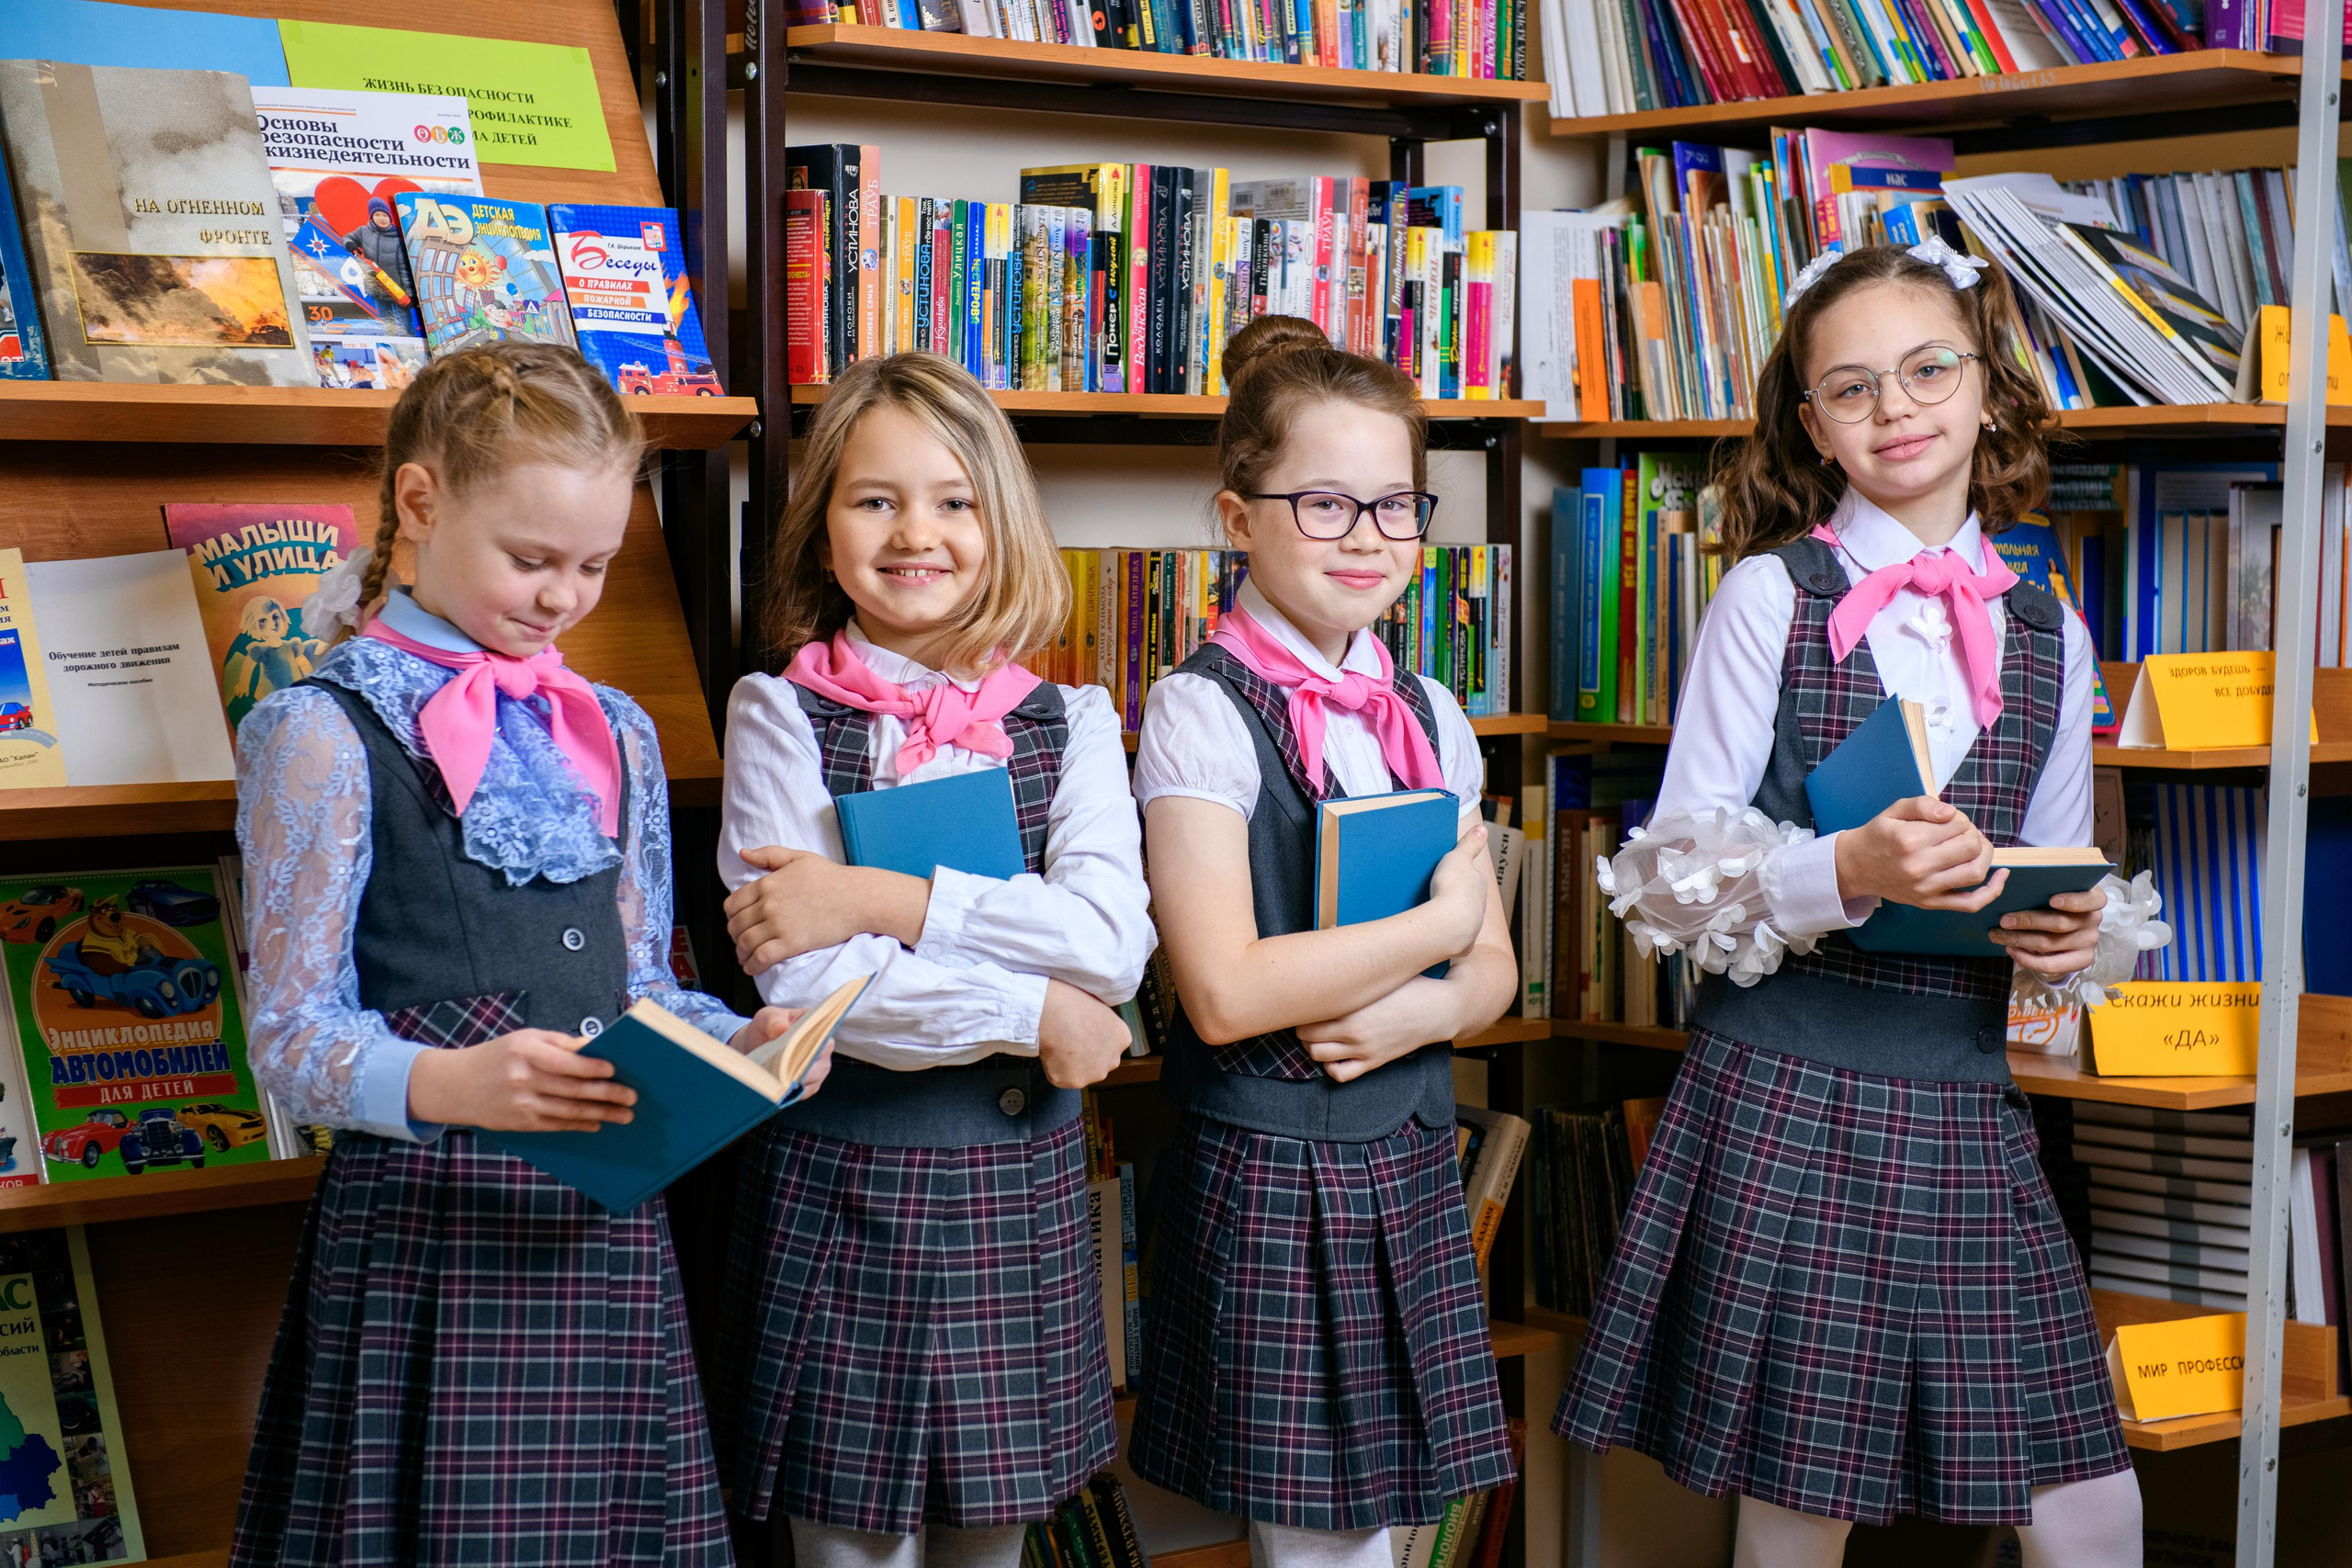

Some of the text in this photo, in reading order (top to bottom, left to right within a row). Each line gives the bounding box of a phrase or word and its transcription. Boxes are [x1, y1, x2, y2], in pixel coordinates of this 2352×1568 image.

[363, 76, 535, 104] ЖИЗНЬ БЕЗ ОПАСНОСТИ
[467, 108, 573, 129] РОФИЛАКТИКЕ
[492, 133, 537, 146] ДЕТЕЙ
[133, 197, 266, 216] НА ОГНЕННОМ
[472, 204, 515, 221] ДЕТСКАЯ
[867, 179, 878, 228] ТРАУБ
[198, 229, 272, 245] ФРОНТЕ
[475, 221, 542, 242] ЭНЦИКЛОПЕДИЯ
[848, 188, 859, 274] УСТИНОВА
[1218, 199, 1227, 246] ТРАУБ
[1321, 207, 1333, 253] ТРАУБ
[568, 230, 658, 276] Беседы
[904, 231, 912, 264] ТРАУБ
[952, 223, 964, 279] Улицкая
[1108, 236, 1118, 288] акулой
[1158, 206, 1168, 289] УСТИНОВА
[1182, 211, 1192, 290] УСТИНОВА
[1261, 232, 1270, 287] Полякова
[587, 280, 633, 291] ПРАВИЛАХ
[918, 244, 932, 328] УСТИНОВА
[1391, 230, 1403, 308] Литвиновы
[583, 293, 632, 306] ПОЖАРНОЙ
[970, 258, 981, 324] НЕСТЕРОВА
[1012, 251, 1023, 334] УСТИНОВА
[308, 305, 334, 321] 30
[587, 309, 652, 321] БЕЗОПАСНОСТИ
[1105, 302, 1118, 355] Покер
[1134, 288, 1148, 366] Веденская
[1214, 328, 1222, 360] Вторая
[1449, 320, 1460, 363] Домик
[192, 519, 340, 565] МАЛЫШИ
[1994, 544, 2040, 557] тольная
[208, 547, 345, 591] И УЛИЦА
[1087, 565, 1095, 613] ШИЛОВА
[49, 642, 181, 661] Обучение детей правилам
[62, 656, 171, 673] дорожного движения
[130, 677, 154, 686] пособие
[2168, 665, 2251, 678] ЗДОРОВ БУДЕШЬ
[2214, 687, 2232, 697] ВСЕ
[2189, 992, 2260, 1008] жизни
[49, 1020, 216, 1052] ЭНЦИКЛОПЕДИЯ
[2163, 1029, 2220, 1050] «ДА»
[50, 1039, 232, 1086] АВТОМОБИЛЕЙ
[100, 1079, 196, 1103] ДЛЯ ДЕТЕЙ
[1127, 1177, 1136, 1227] ЗАКРЫТЫЙ
[1125, 1263, 1138, 1303] 3000
[1127, 1321, 1136, 1371] МАТЕМАТИКЕ
[1133, 1335, 1141, 1370] ОТВЕТАМИ
[2137, 1363, 2168, 1379] МИР
[1434, 1503, 1464, 1568] БИОЛОГИ
